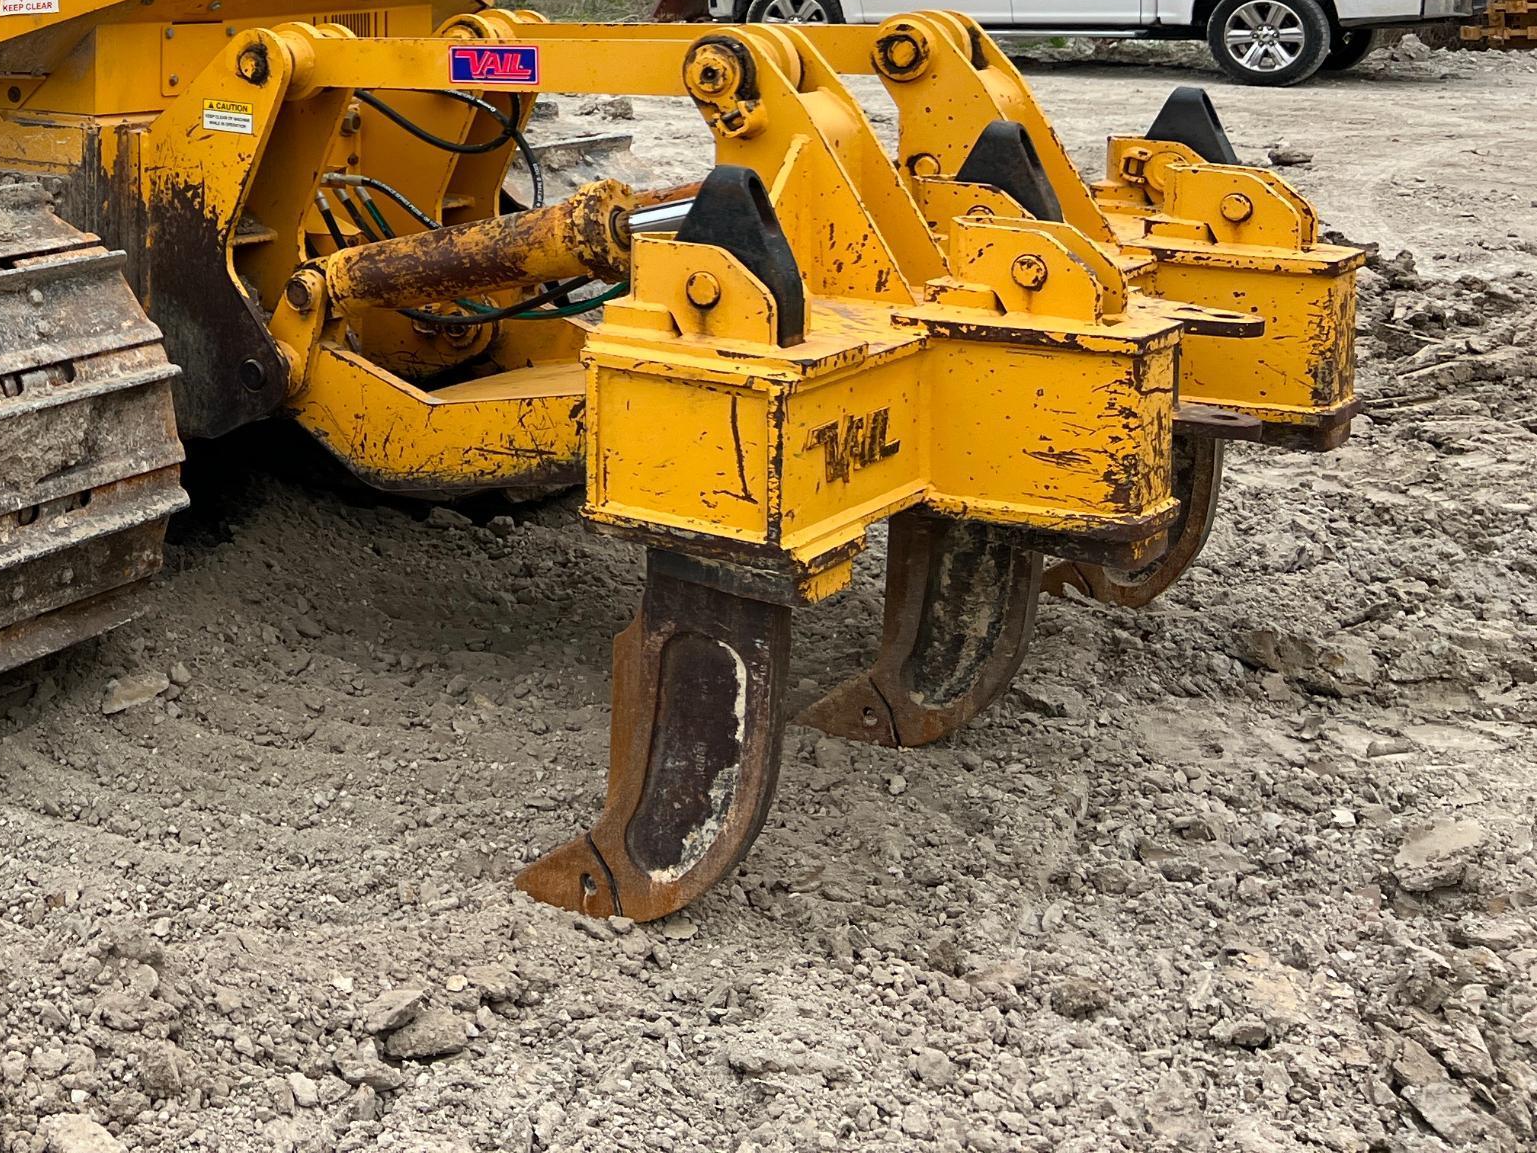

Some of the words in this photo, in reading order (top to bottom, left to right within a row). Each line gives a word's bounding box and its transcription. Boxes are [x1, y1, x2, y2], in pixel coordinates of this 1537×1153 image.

[3, 4, 24, 12] KEEP
[25, 1, 53, 10] CLEAR
[216, 102, 248, 112] CAUTION
